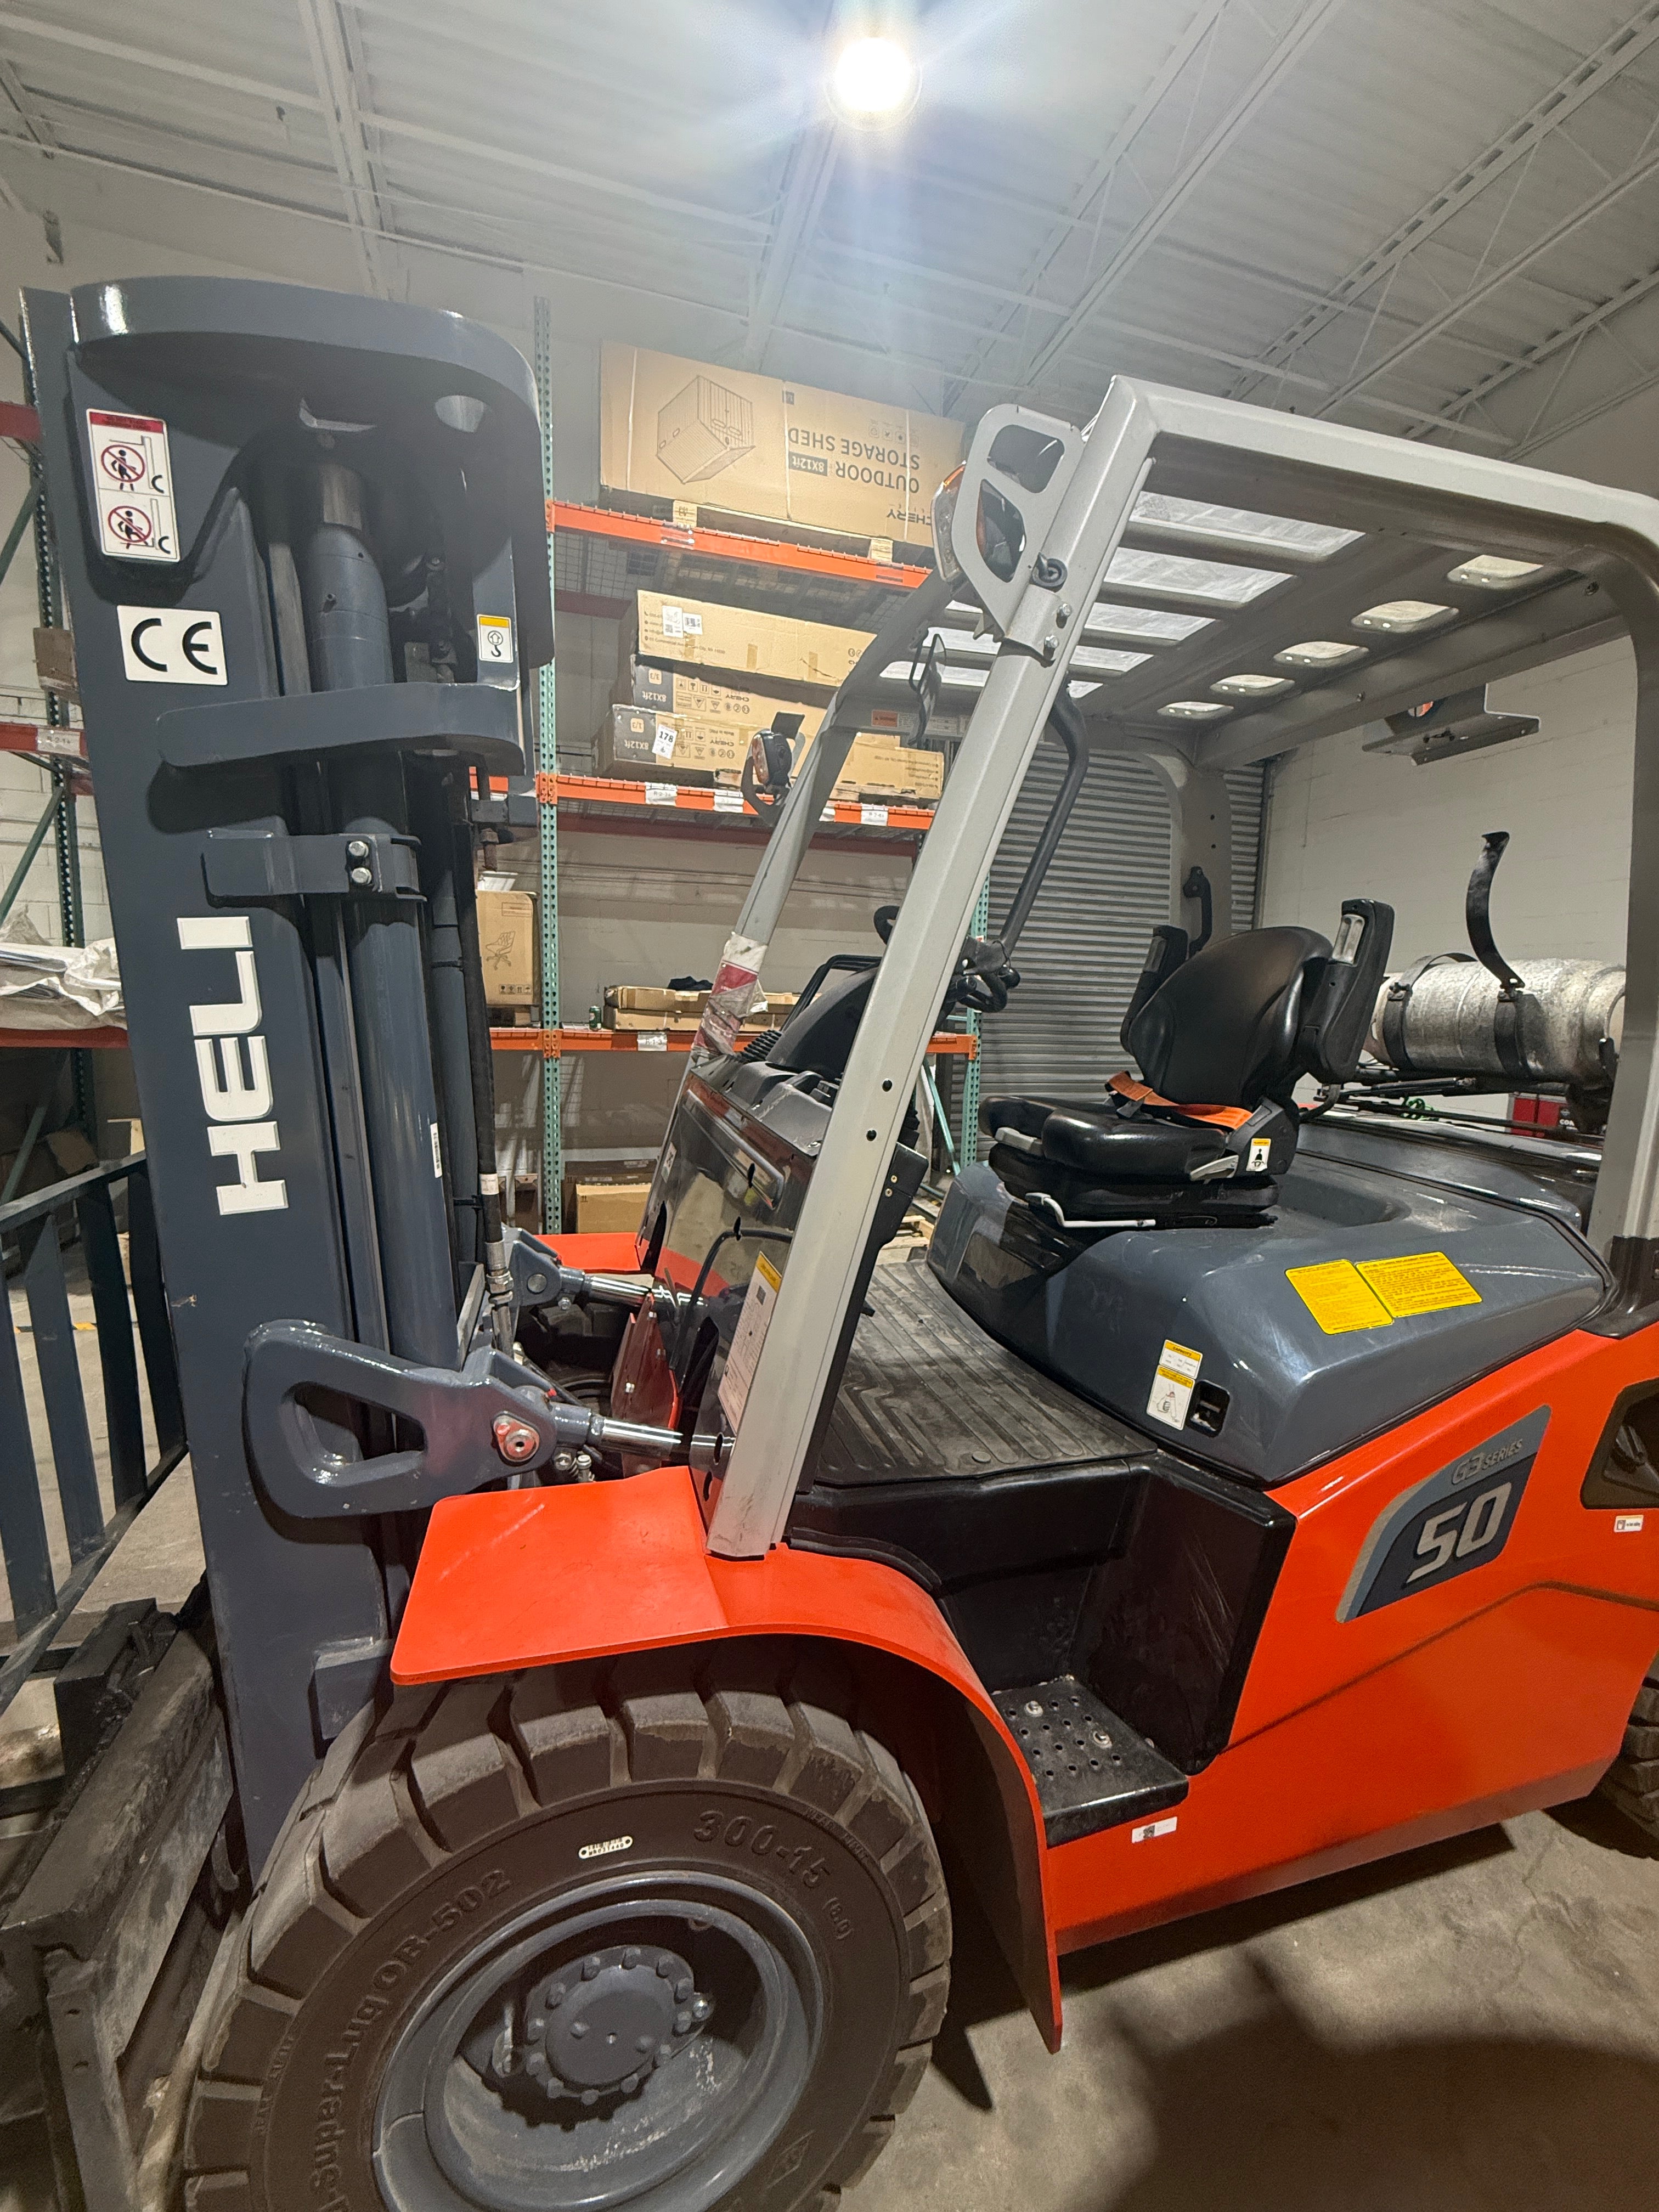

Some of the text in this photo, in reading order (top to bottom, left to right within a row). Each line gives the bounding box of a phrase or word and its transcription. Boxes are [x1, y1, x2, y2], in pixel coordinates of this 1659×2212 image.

[787, 428, 920, 470] STORAGE SHED
[792, 456, 920, 494] OUTDOOR 8X12ft
[131, 617, 217, 675] CE
[641, 691, 667, 703] 8X12ft
[623, 738, 650, 750] 8X12ft
[659, 731, 674, 742] 178
[709, 739, 735, 747] CHERY
[177, 915, 288, 1216] HELI
[1406, 1481, 1512, 1584] 50
[693, 1809, 832, 1889] 300-15
